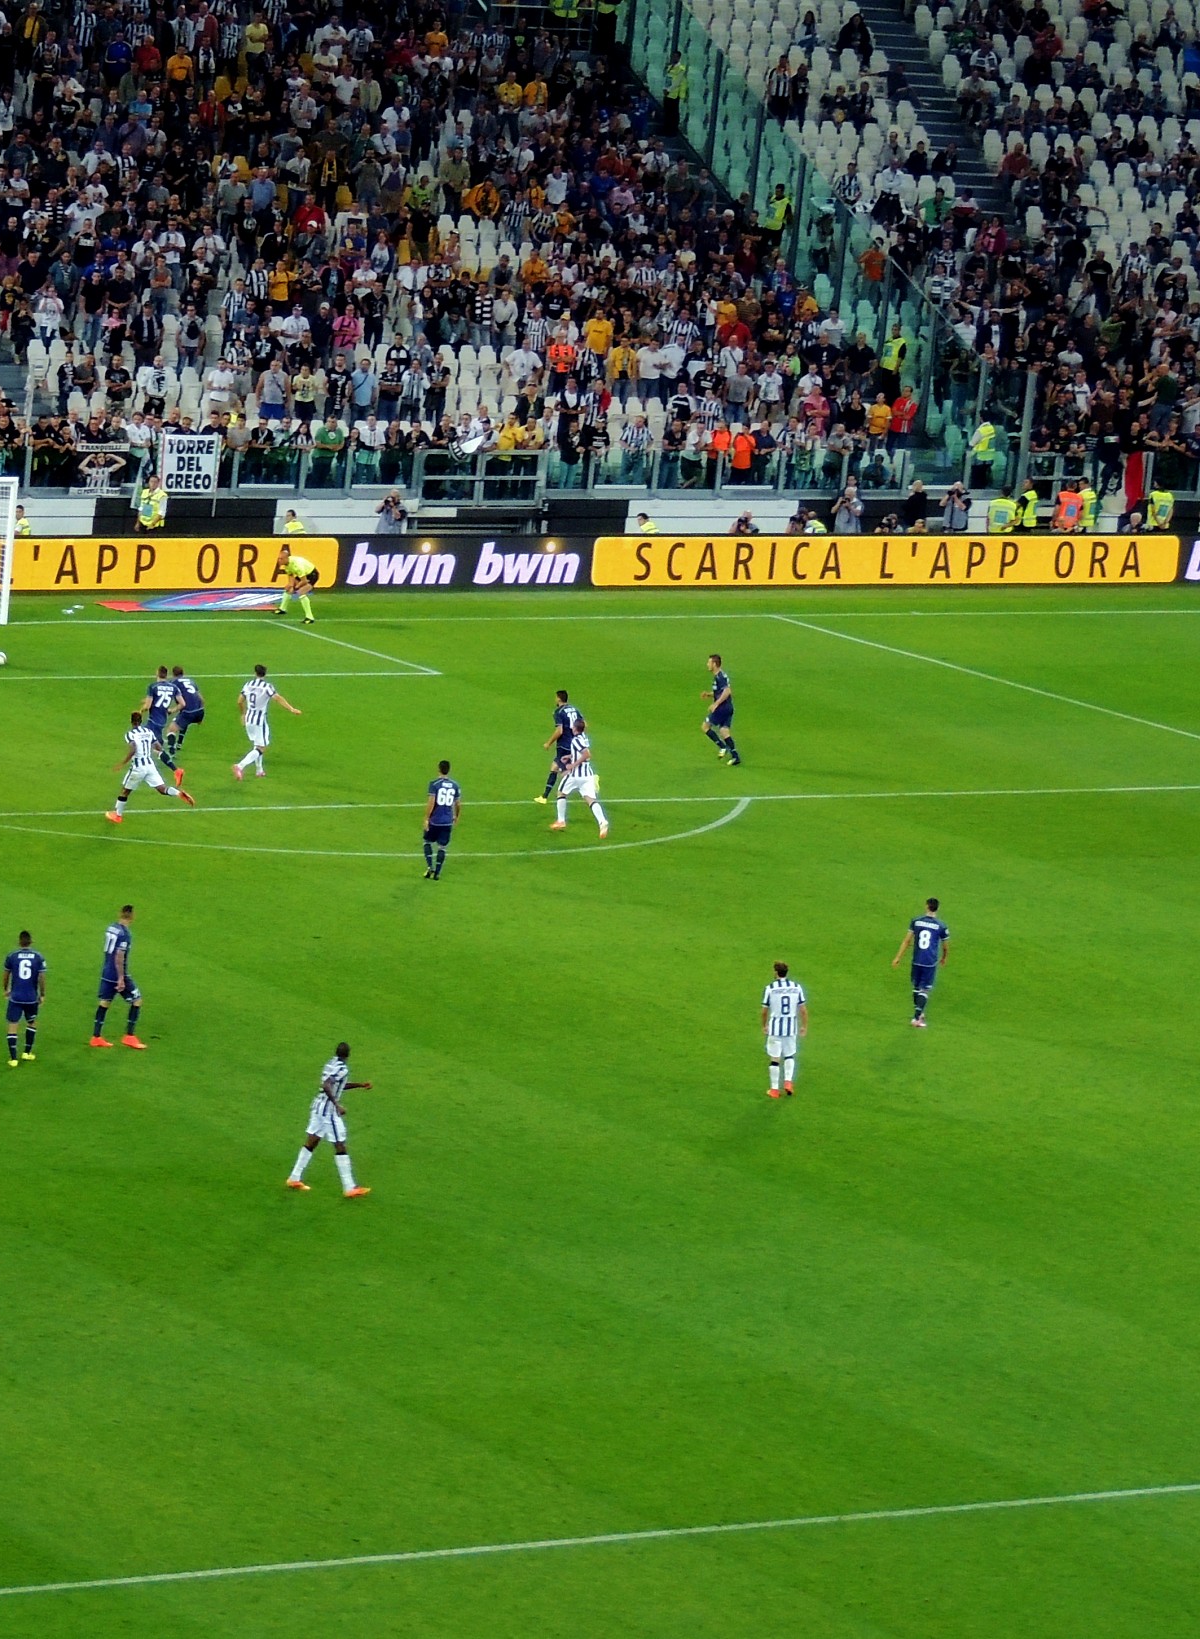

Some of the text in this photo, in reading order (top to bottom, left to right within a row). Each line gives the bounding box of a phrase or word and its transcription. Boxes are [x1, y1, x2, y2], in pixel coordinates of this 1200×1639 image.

[168, 439, 215, 454] TORRE
[176, 457, 202, 471] DEL
[166, 474, 211, 489] GRECO
[345, 541, 456, 585] bwin
[472, 541, 580, 585] bwin
[633, 541, 842, 581] SCARICA
[879, 541, 1019, 579] L'APP
[1054, 541, 1141, 579] ORA
[182, 681, 196, 694] 5
[249, 693, 256, 709] 9
[436, 787, 455, 807] 66
[918, 929, 931, 950] 8
[18, 959, 32, 980] 6
[781, 995, 790, 1015] 8
